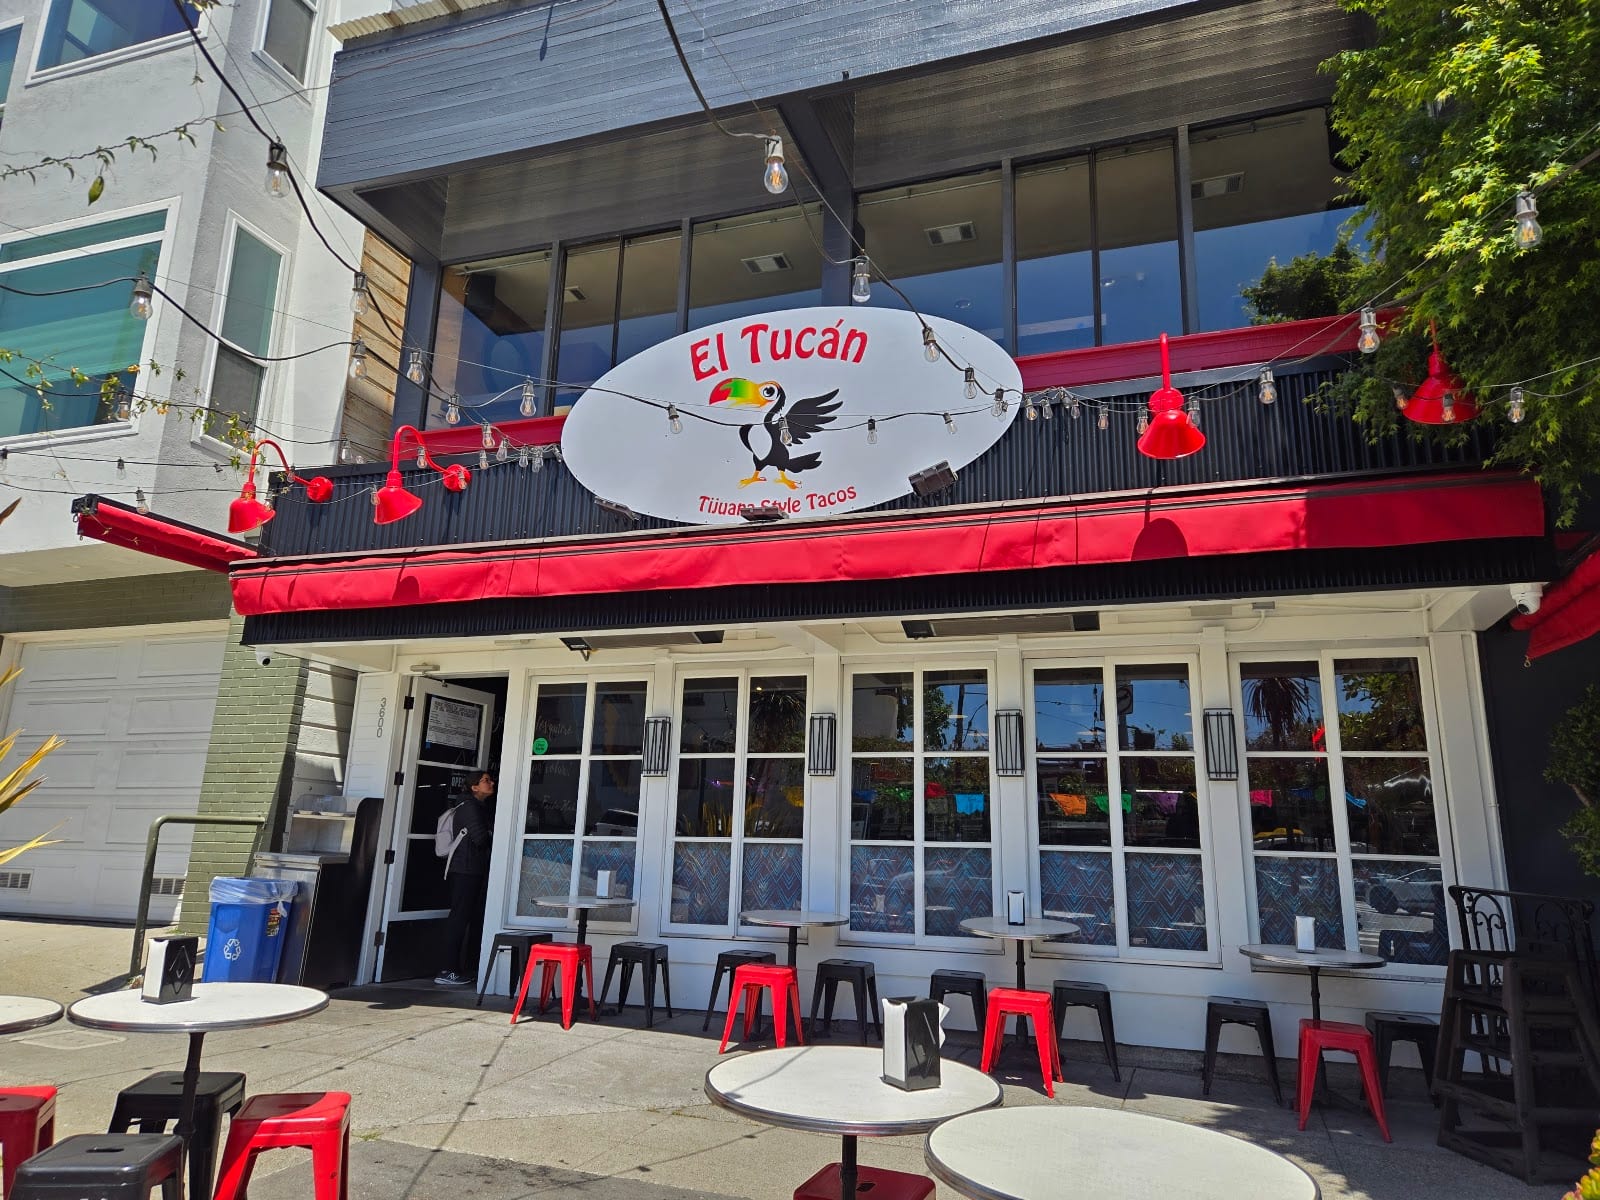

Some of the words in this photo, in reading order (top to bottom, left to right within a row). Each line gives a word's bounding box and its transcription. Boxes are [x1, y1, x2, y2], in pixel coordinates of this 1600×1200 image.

[690, 332, 729, 382] El
[740, 319, 869, 364] Tucán
[805, 486, 857, 510] Tacos
[376, 697, 388, 738] 3600
